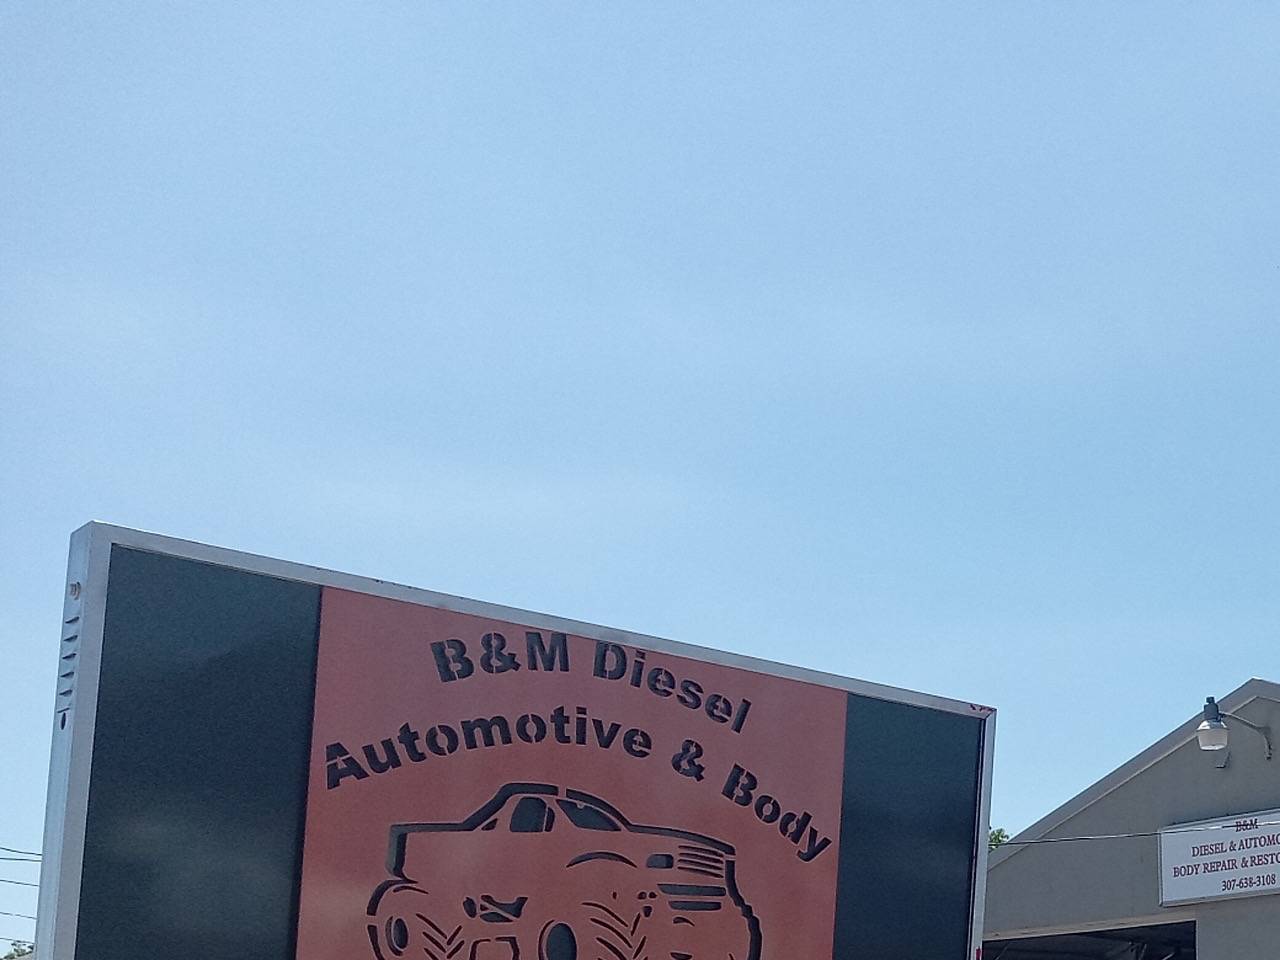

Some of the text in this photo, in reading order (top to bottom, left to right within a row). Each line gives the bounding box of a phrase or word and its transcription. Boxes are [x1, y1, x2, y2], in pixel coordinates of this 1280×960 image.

[430, 631, 752, 734] B&M Diesel
[325, 706, 832, 863] Automotive & Body
[1235, 818, 1259, 832] B&M
[1192, 842, 1227, 857] DIESEL
[1229, 840, 1237, 852] &
[1173, 863, 1201, 877] BODY
[1202, 857, 1238, 874] REPAIR
[1241, 857, 1249, 869] &
[1222, 874, 1276, 891] 307-638-3108
